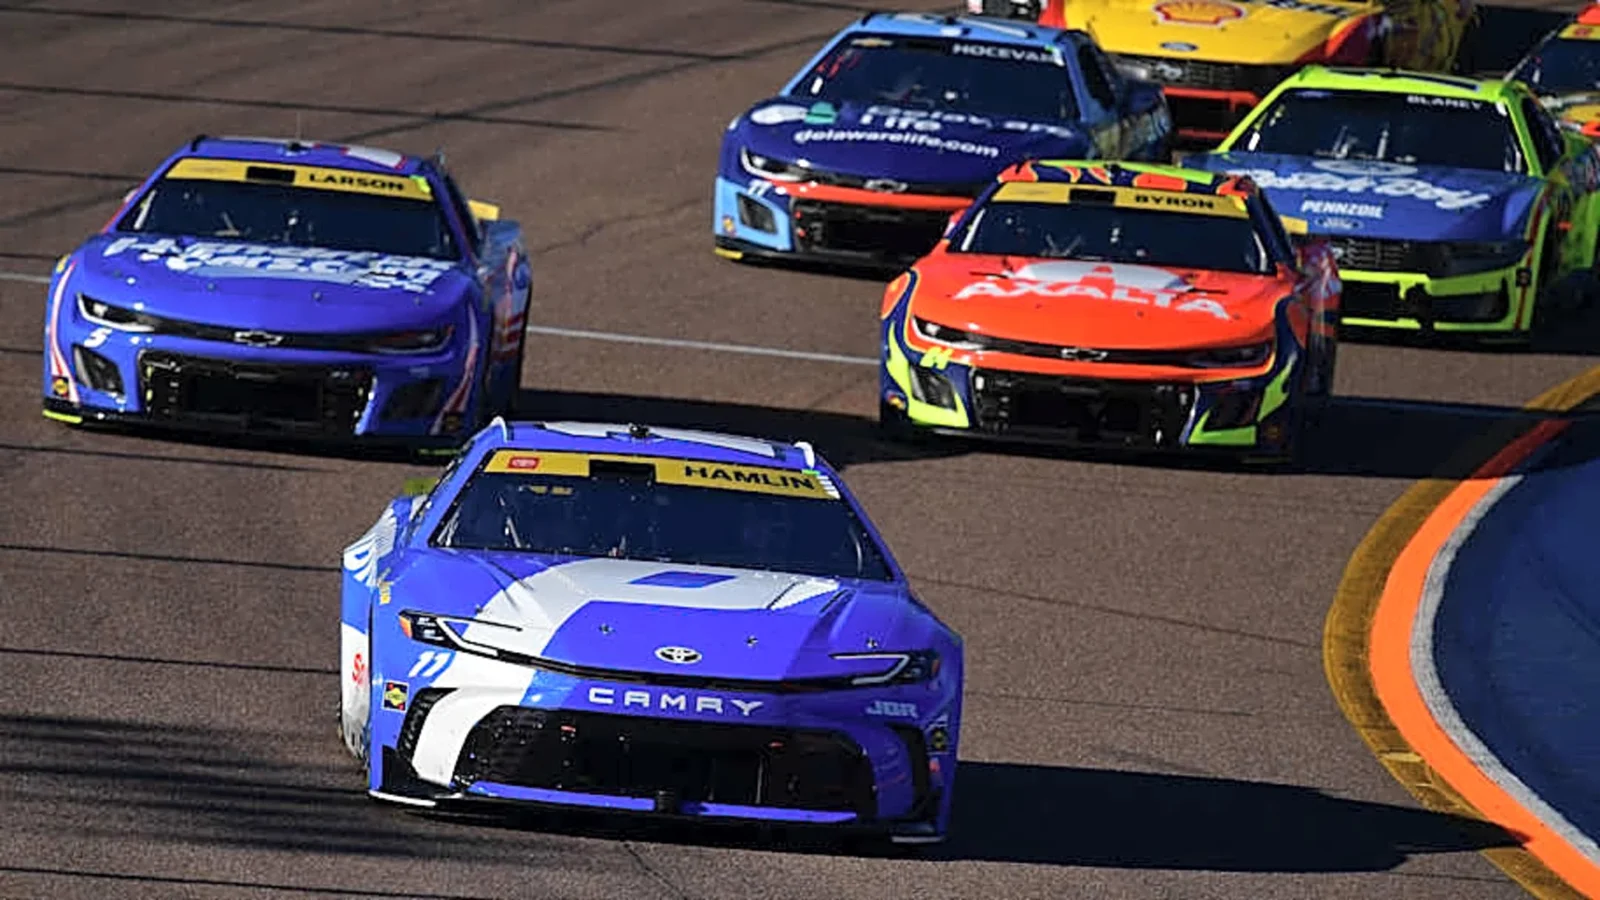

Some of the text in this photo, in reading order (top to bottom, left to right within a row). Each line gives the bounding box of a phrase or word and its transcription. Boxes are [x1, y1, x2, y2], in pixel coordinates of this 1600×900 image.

[1407, 95, 1482, 110] BLANEY
[794, 129, 999, 158] delawarelife.com
[309, 174, 404, 190] LARSON
[1134, 194, 1215, 210] BYRON
[1301, 199, 1384, 219] PENNZOIL
[953, 280, 1230, 321] AXALTA
[84, 328, 112, 347] 5
[684, 464, 815, 490] HAMLIN
[408, 651, 448, 677] 11
[588, 686, 763, 716] CAMRY
